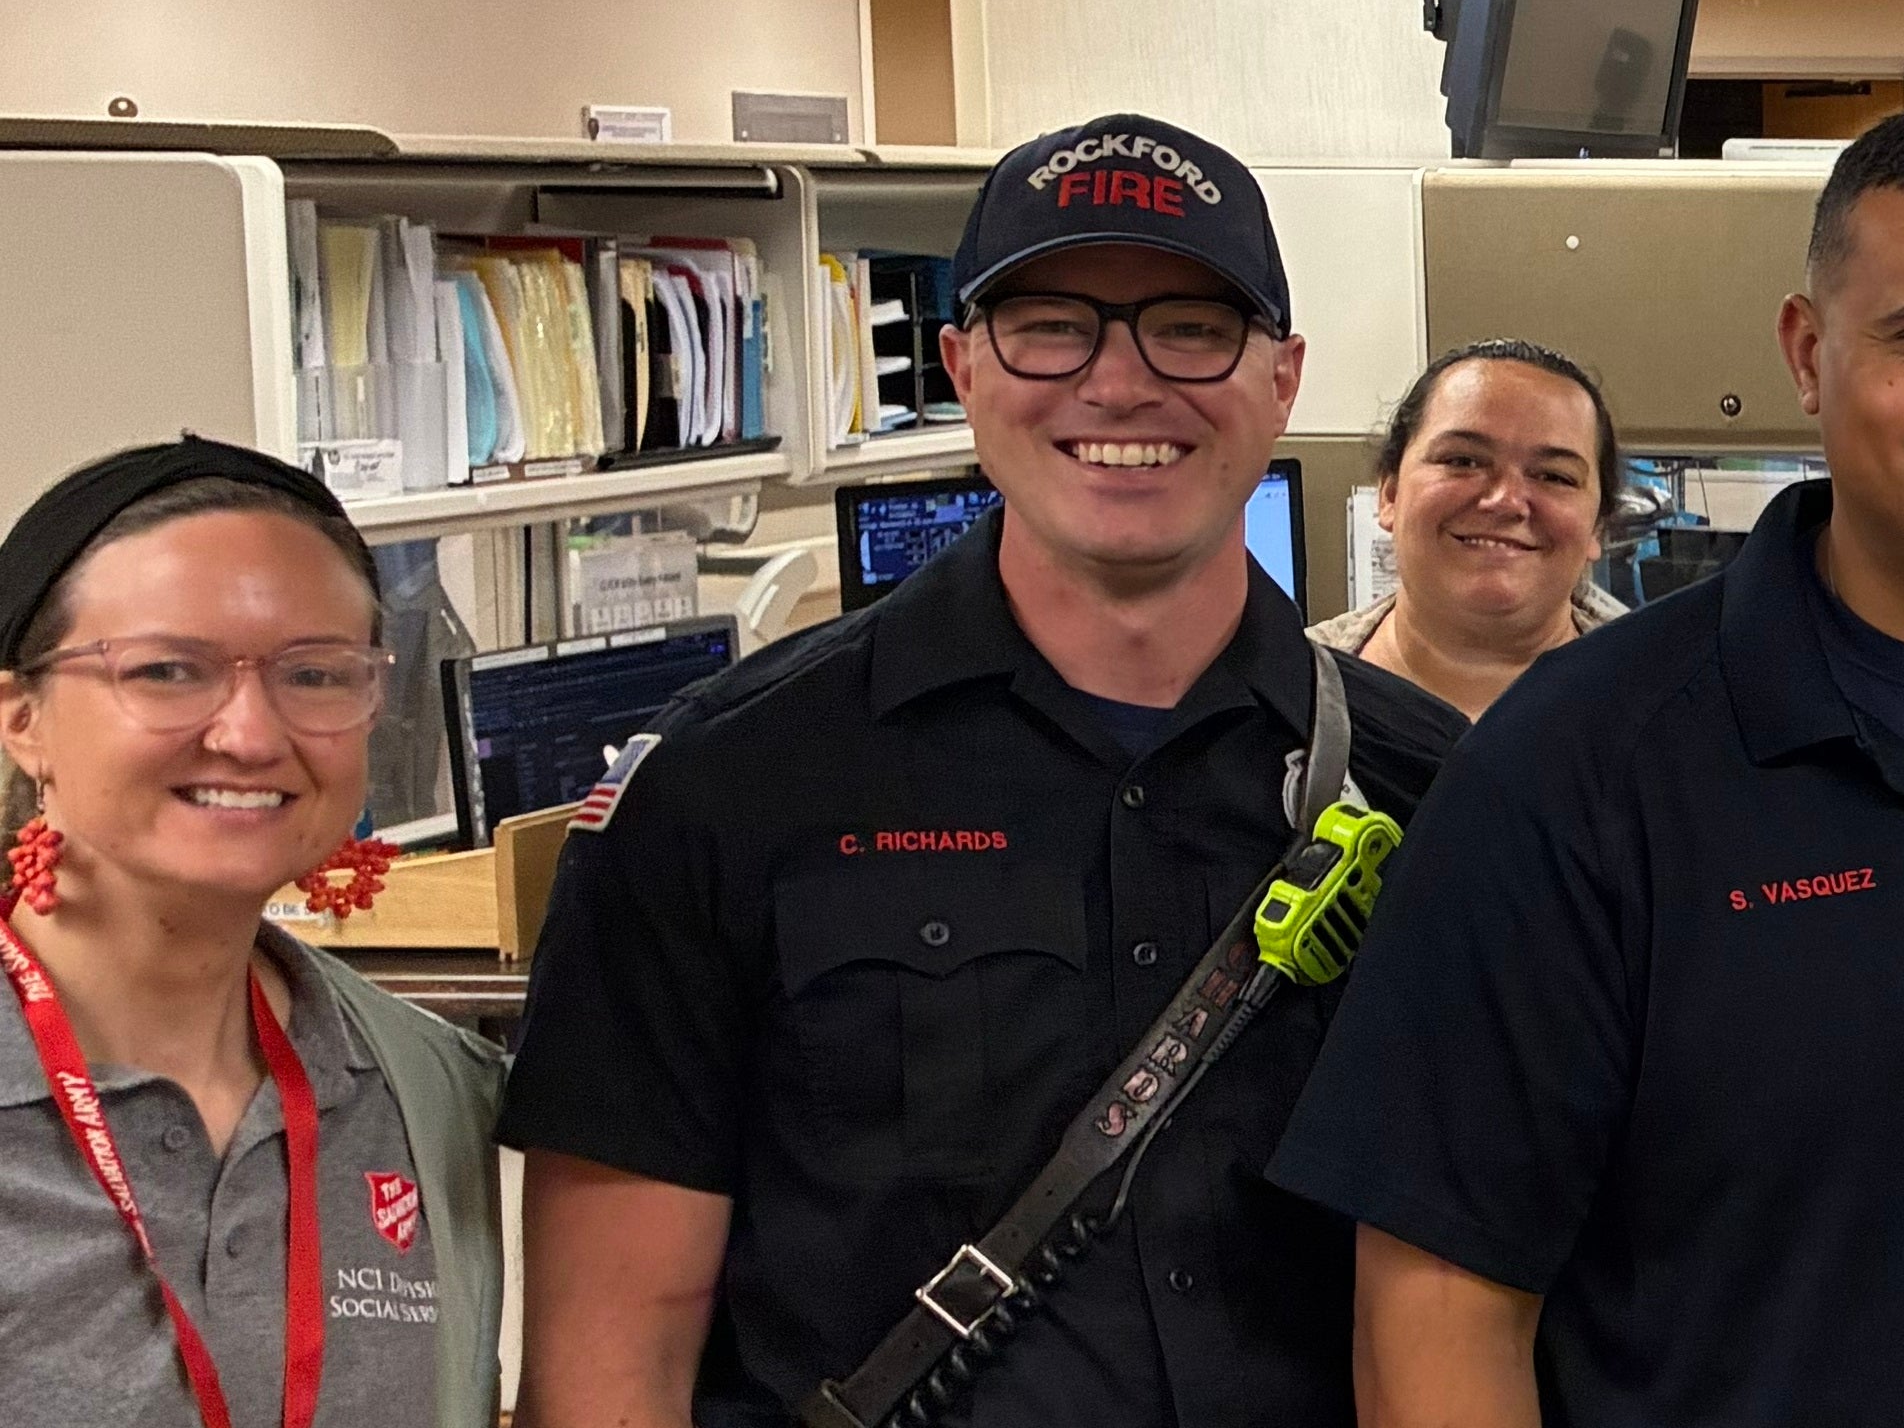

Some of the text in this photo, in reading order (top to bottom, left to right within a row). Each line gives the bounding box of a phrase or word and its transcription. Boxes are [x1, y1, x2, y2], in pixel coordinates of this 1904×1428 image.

[1027, 133, 1223, 205] ROCKFORD
[1057, 169, 1186, 218] FIRE
[839, 830, 1008, 855] C. RICHARDS
[1761, 867, 1878, 905] VASQUEZ
[338, 1268, 383, 1291] NCI
